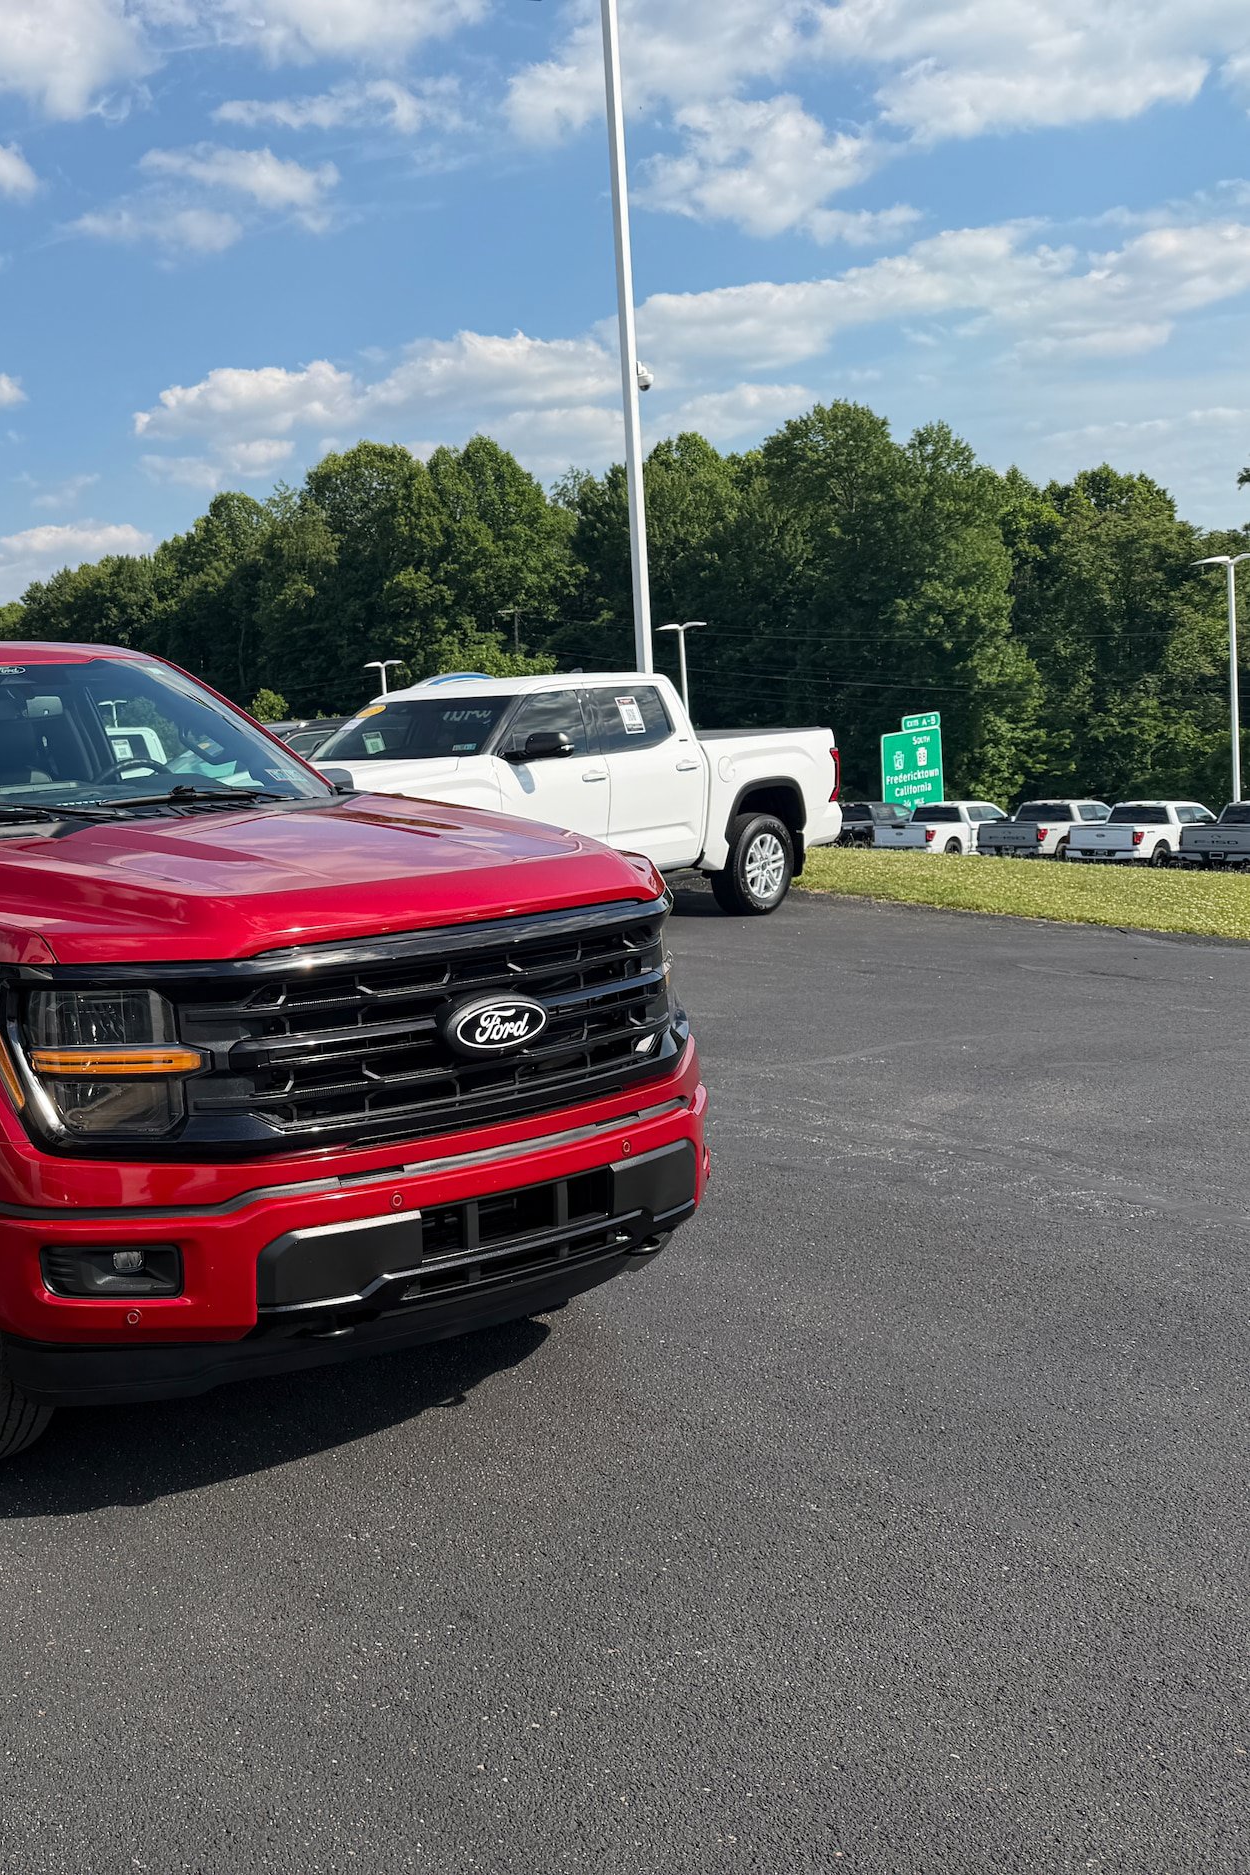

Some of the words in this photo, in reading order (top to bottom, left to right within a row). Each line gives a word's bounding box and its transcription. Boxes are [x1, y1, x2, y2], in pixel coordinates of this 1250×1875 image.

[886, 768, 939, 785] Fredericktown
[895, 782, 932, 797] California
[474, 1008, 530, 1043] Ford
